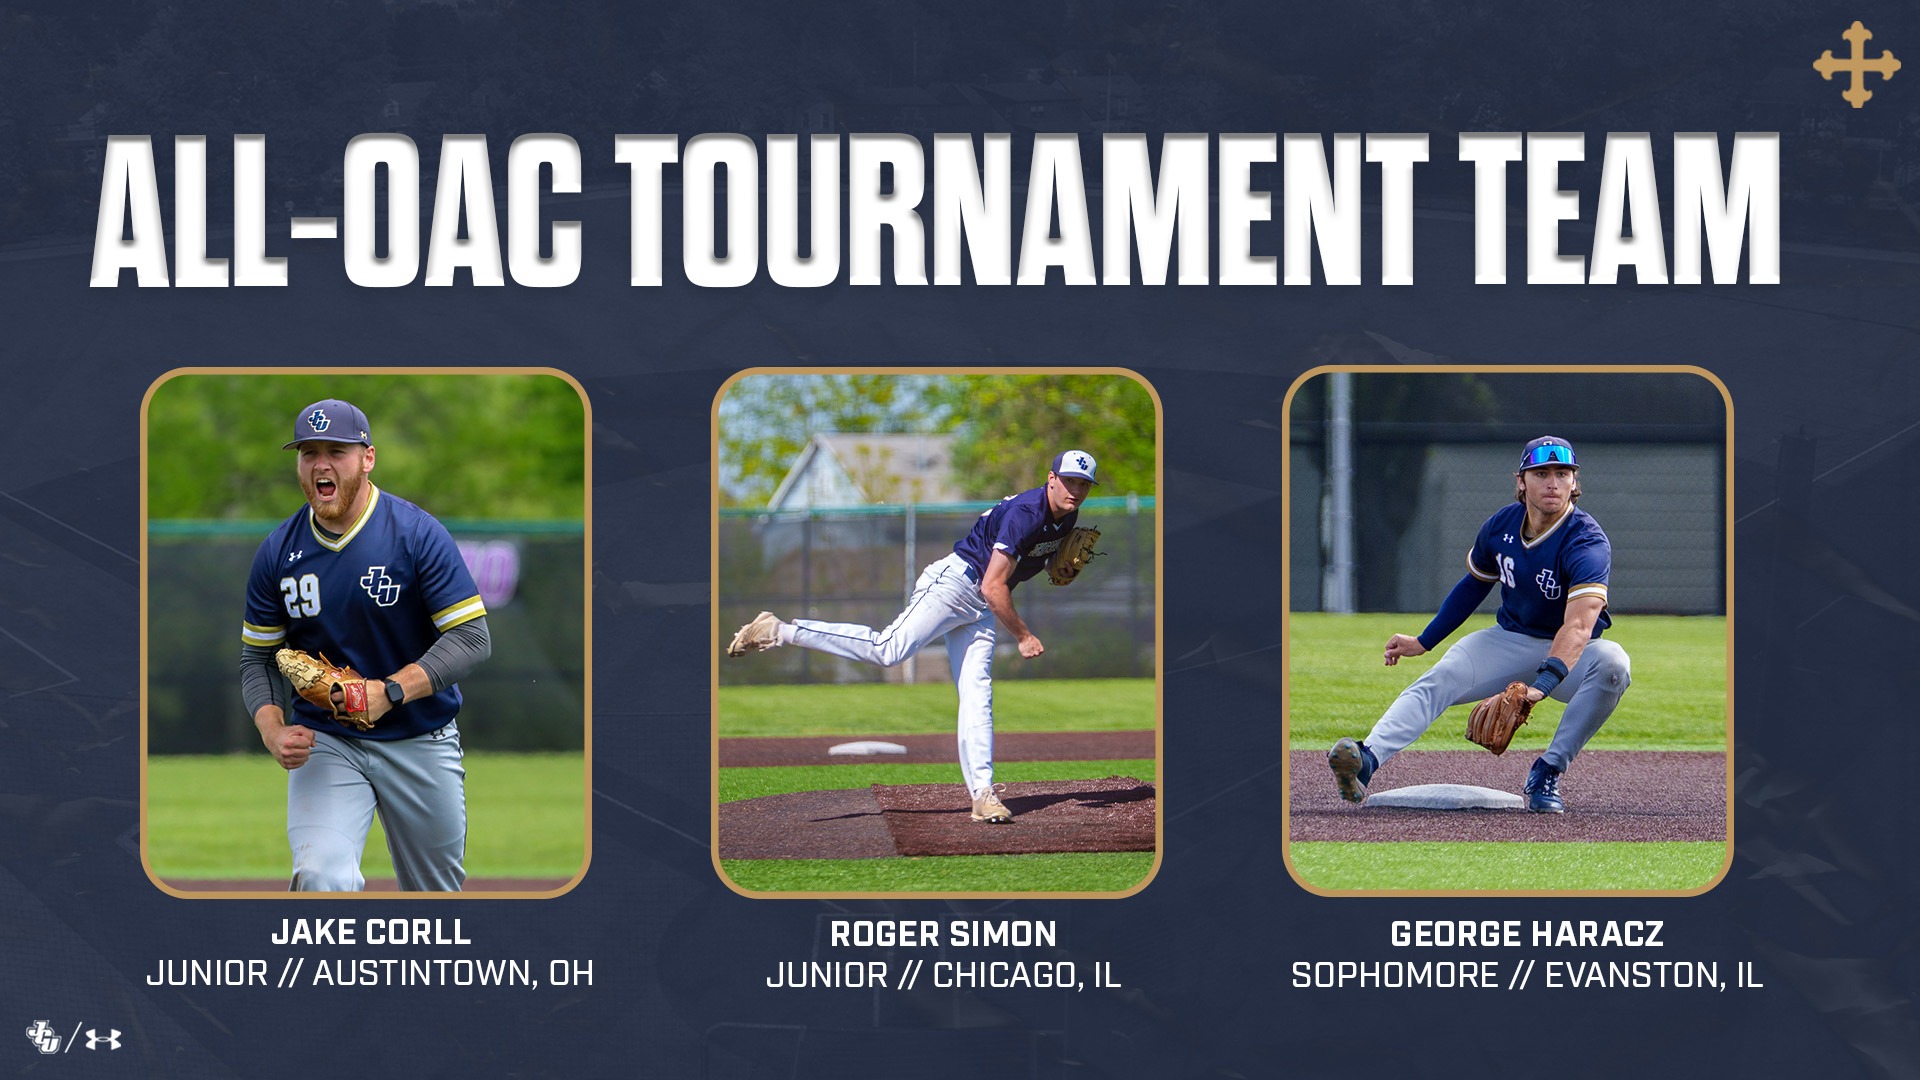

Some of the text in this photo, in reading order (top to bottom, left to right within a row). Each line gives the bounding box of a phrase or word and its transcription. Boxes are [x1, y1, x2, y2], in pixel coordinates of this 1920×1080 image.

[308, 409, 331, 433] JCU
[360, 566, 401, 607] JCU
[1495, 552, 1516, 589] 16
[1535, 568, 1562, 600] JCU
[280, 573, 322, 619] 29
